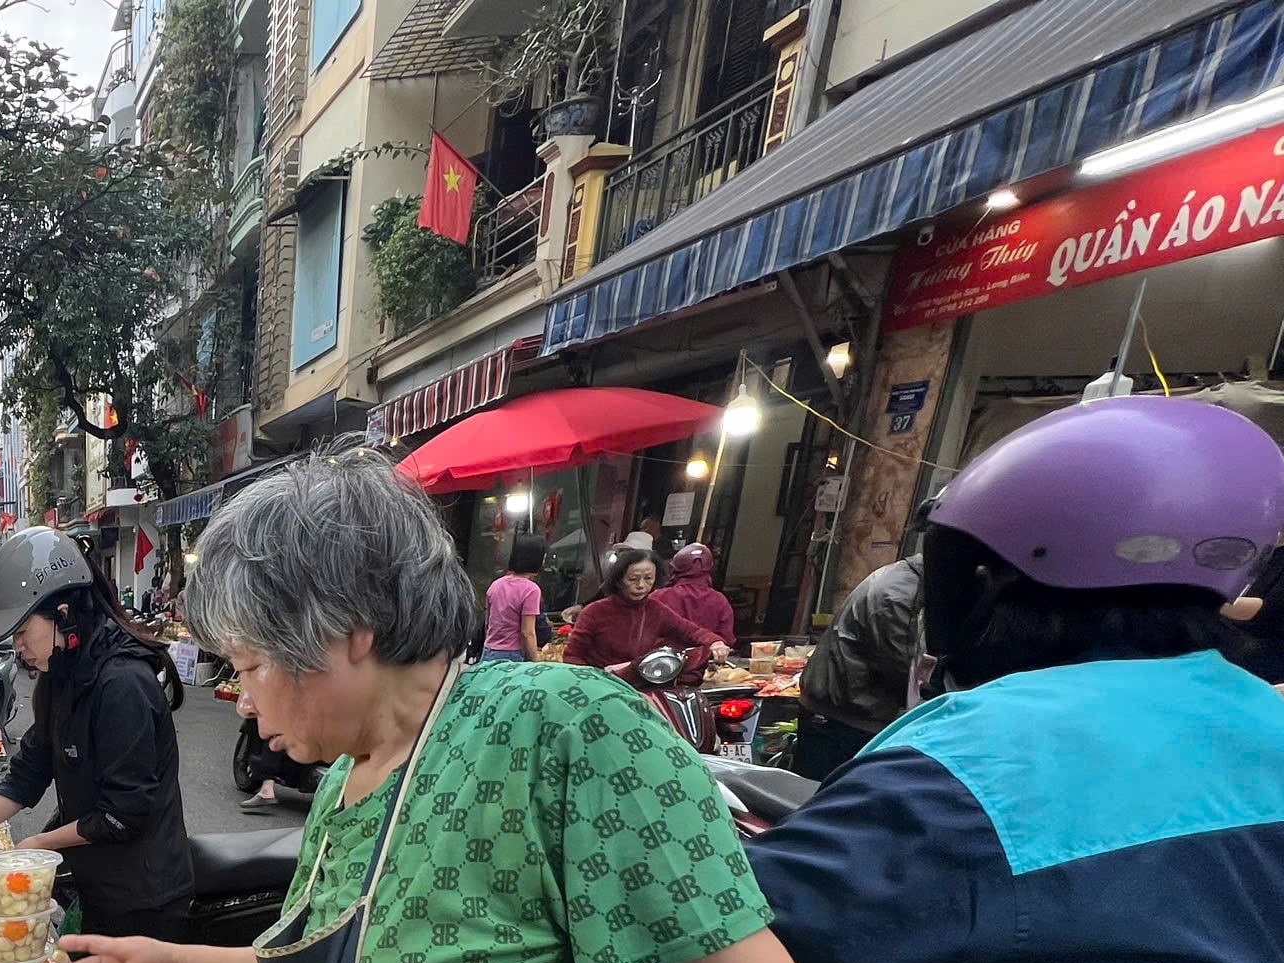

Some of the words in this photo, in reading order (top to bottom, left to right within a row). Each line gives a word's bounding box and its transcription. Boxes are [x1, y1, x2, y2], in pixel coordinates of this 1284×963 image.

[972, 219, 1021, 247] HÀNG
[1046, 199, 1162, 287] QUẦN
[1157, 189, 1226, 252] ÁO
[979, 239, 1039, 271] Thúy
[893, 415, 911, 431] 37
